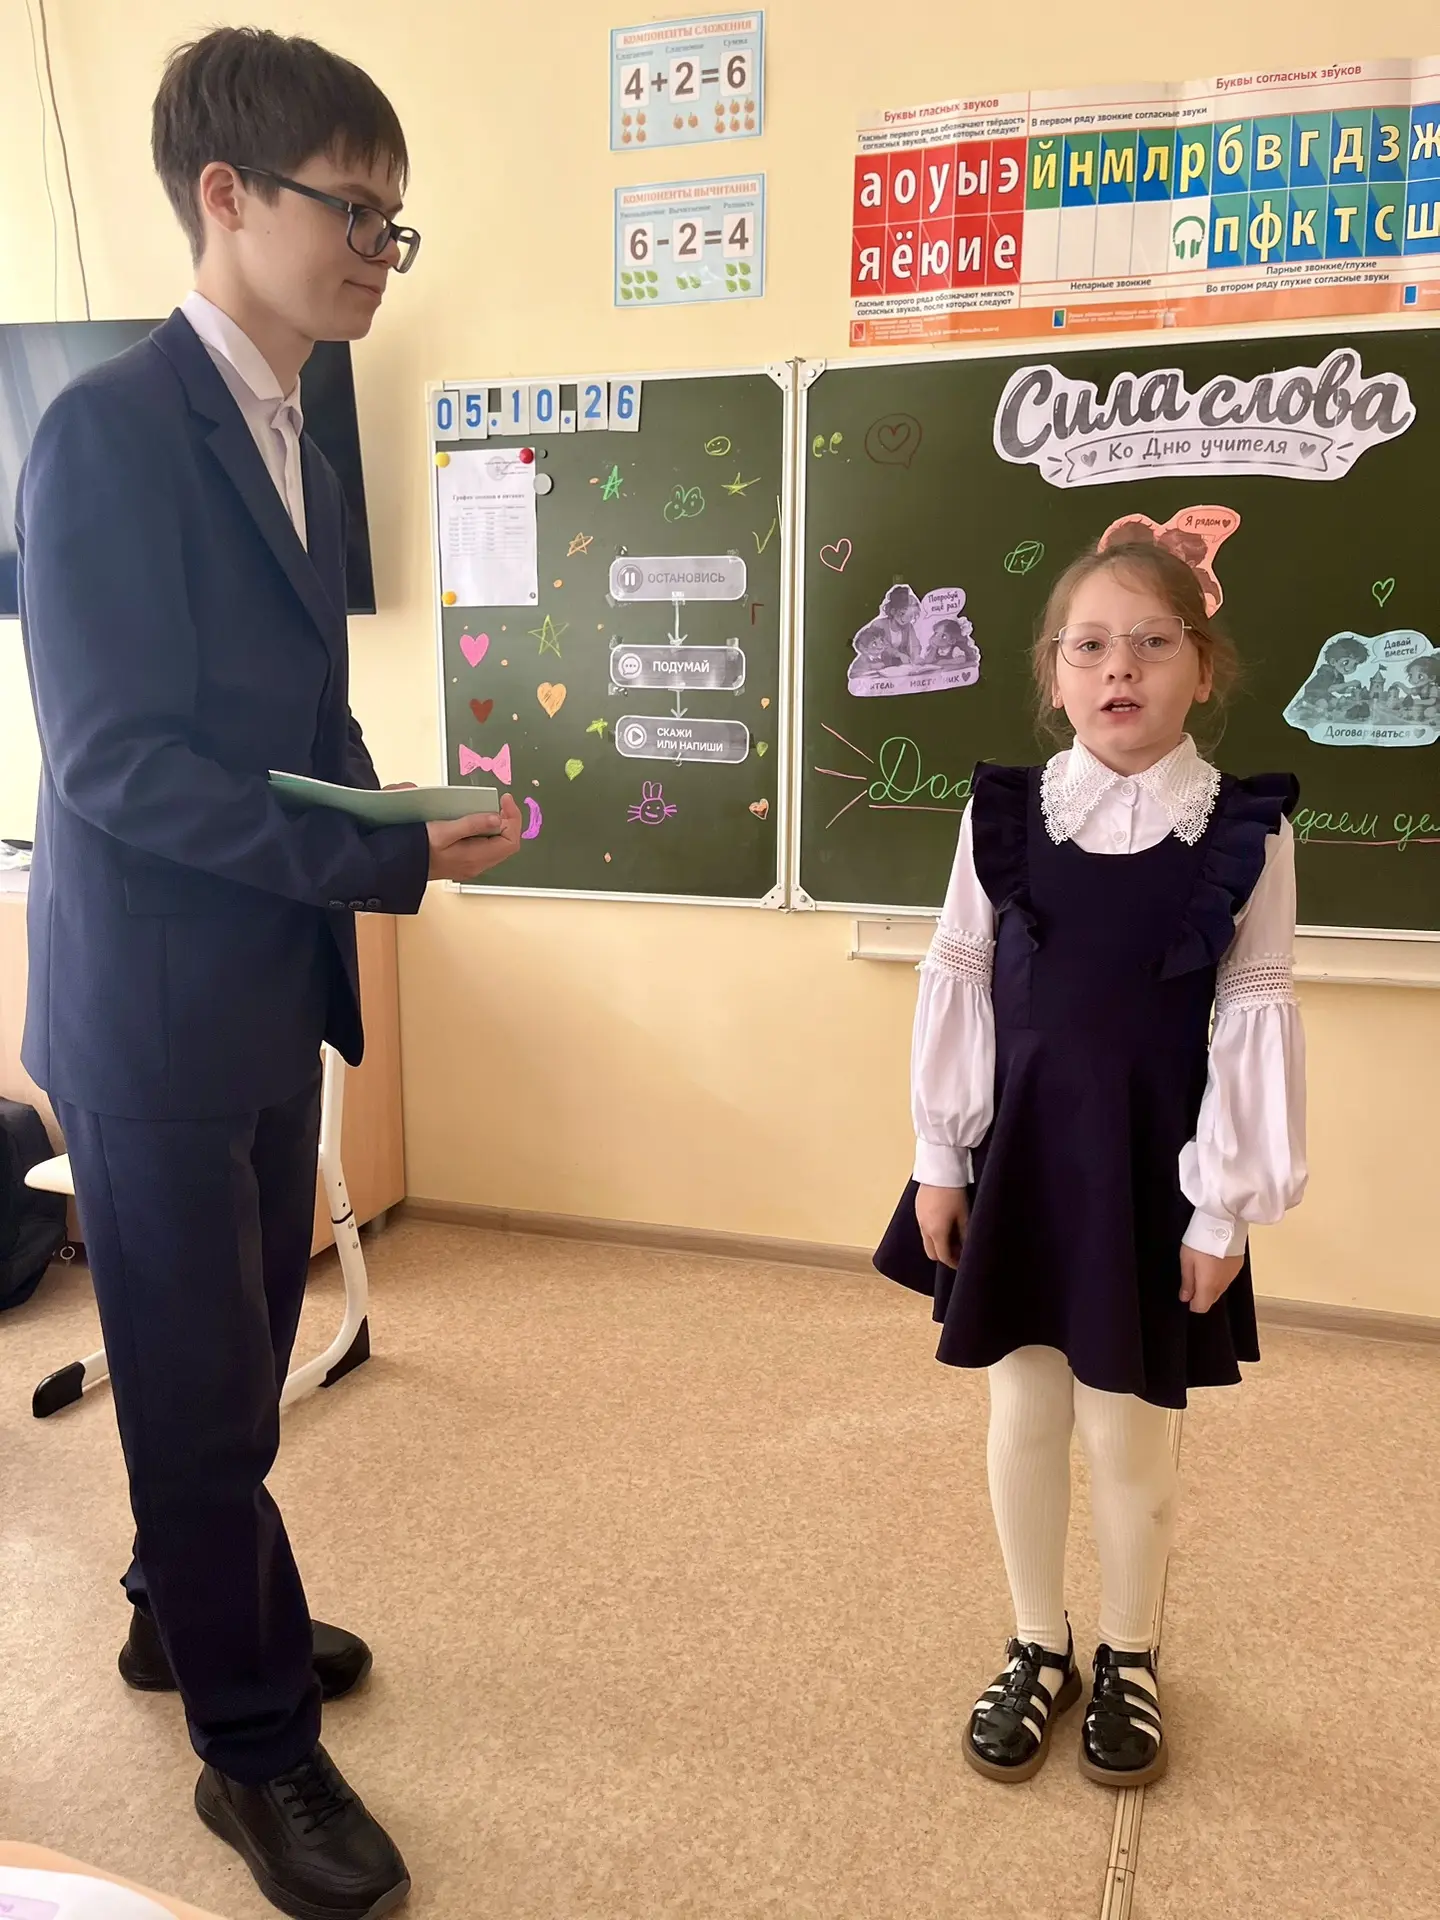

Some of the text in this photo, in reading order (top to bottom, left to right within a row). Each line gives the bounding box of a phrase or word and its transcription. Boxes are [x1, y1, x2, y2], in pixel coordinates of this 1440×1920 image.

[623, 20, 752, 45] КОМПОНЕНТЫ СЛОЖЕНИЯ
[624, 68, 643, 100] 4
[675, 62, 694, 96] 2
[727, 55, 746, 89] 6
[1216, 66, 1362, 90] Буквы согласных звуков
[884, 98, 999, 123] Буквы гласных звуков
[1031, 107, 1207, 127] В первом ряду звонкие согласные звуки
[858, 134, 888, 143] Гласные
[890, 130, 919, 140] первого
[921, 127, 938, 137] ряда
[940, 121, 984, 132] обозначают
[863, 140, 900, 150] согласных
[930, 134, 951, 142] после
[953, 130, 984, 140] которых
[987, 126, 1020, 137] следуют
[1032, 140, 1057, 190] й
[1069, 151, 1093, 188] н
[1102, 148, 1134, 185] м
[1143, 146, 1169, 182] л
[1179, 142, 1206, 193] р
[1218, 124, 1243, 175] б
[1256, 134, 1282, 171] в
[1299, 130, 1320, 167] г
[1333, 127, 1364, 174] д
[1377, 125, 1400, 163] з
[623, 182, 757, 204] КОМПОНЕНТЫ ВЫЧИТАНИЯ
[860, 157, 1020, 214] а о у ы э
[630, 228, 648, 260] 6
[678, 222, 697, 256] 2
[728, 217, 749, 250] 4
[1214, 216, 1240, 253] п
[1249, 200, 1283, 262] ф
[1292, 209, 1318, 246] к
[1334, 207, 1358, 243] т
[1374, 205, 1395, 242] с
[857, 231, 1017, 282] я ё ю и е
[1266, 260, 1377, 277] Парные звонкие/глухие
[1070, 278, 1151, 291] Непарные звонкие
[1206, 272, 1389, 294] Во втором ряду глухие согласные звуки
[855, 289, 1014, 308] Гласные второго ряда обозначают мягкость
[857, 308, 894, 317] согласных
[923, 303, 945, 311] после
[946, 300, 977, 309] которых
[979, 298, 1011, 307] следуют
[437, 384, 634, 431] 05.10.26
[1000, 352, 1411, 458] Сила слова
[1109, 437, 1287, 461] Ко Дню учителя
[1185, 516, 1221, 529] Я рядом
[647, 572, 726, 584] ОСТАНОВИСЬ
[928, 591, 959, 604] Попробуй
[1384, 637, 1411, 651] Давай
[1385, 645, 1418, 658] вместе!
[652, 659, 710, 674] ПОДУМАЙ
[657, 727, 692, 738] СКАЖИ
[657, 740, 723, 752] ИЛИ НАПИШИ
